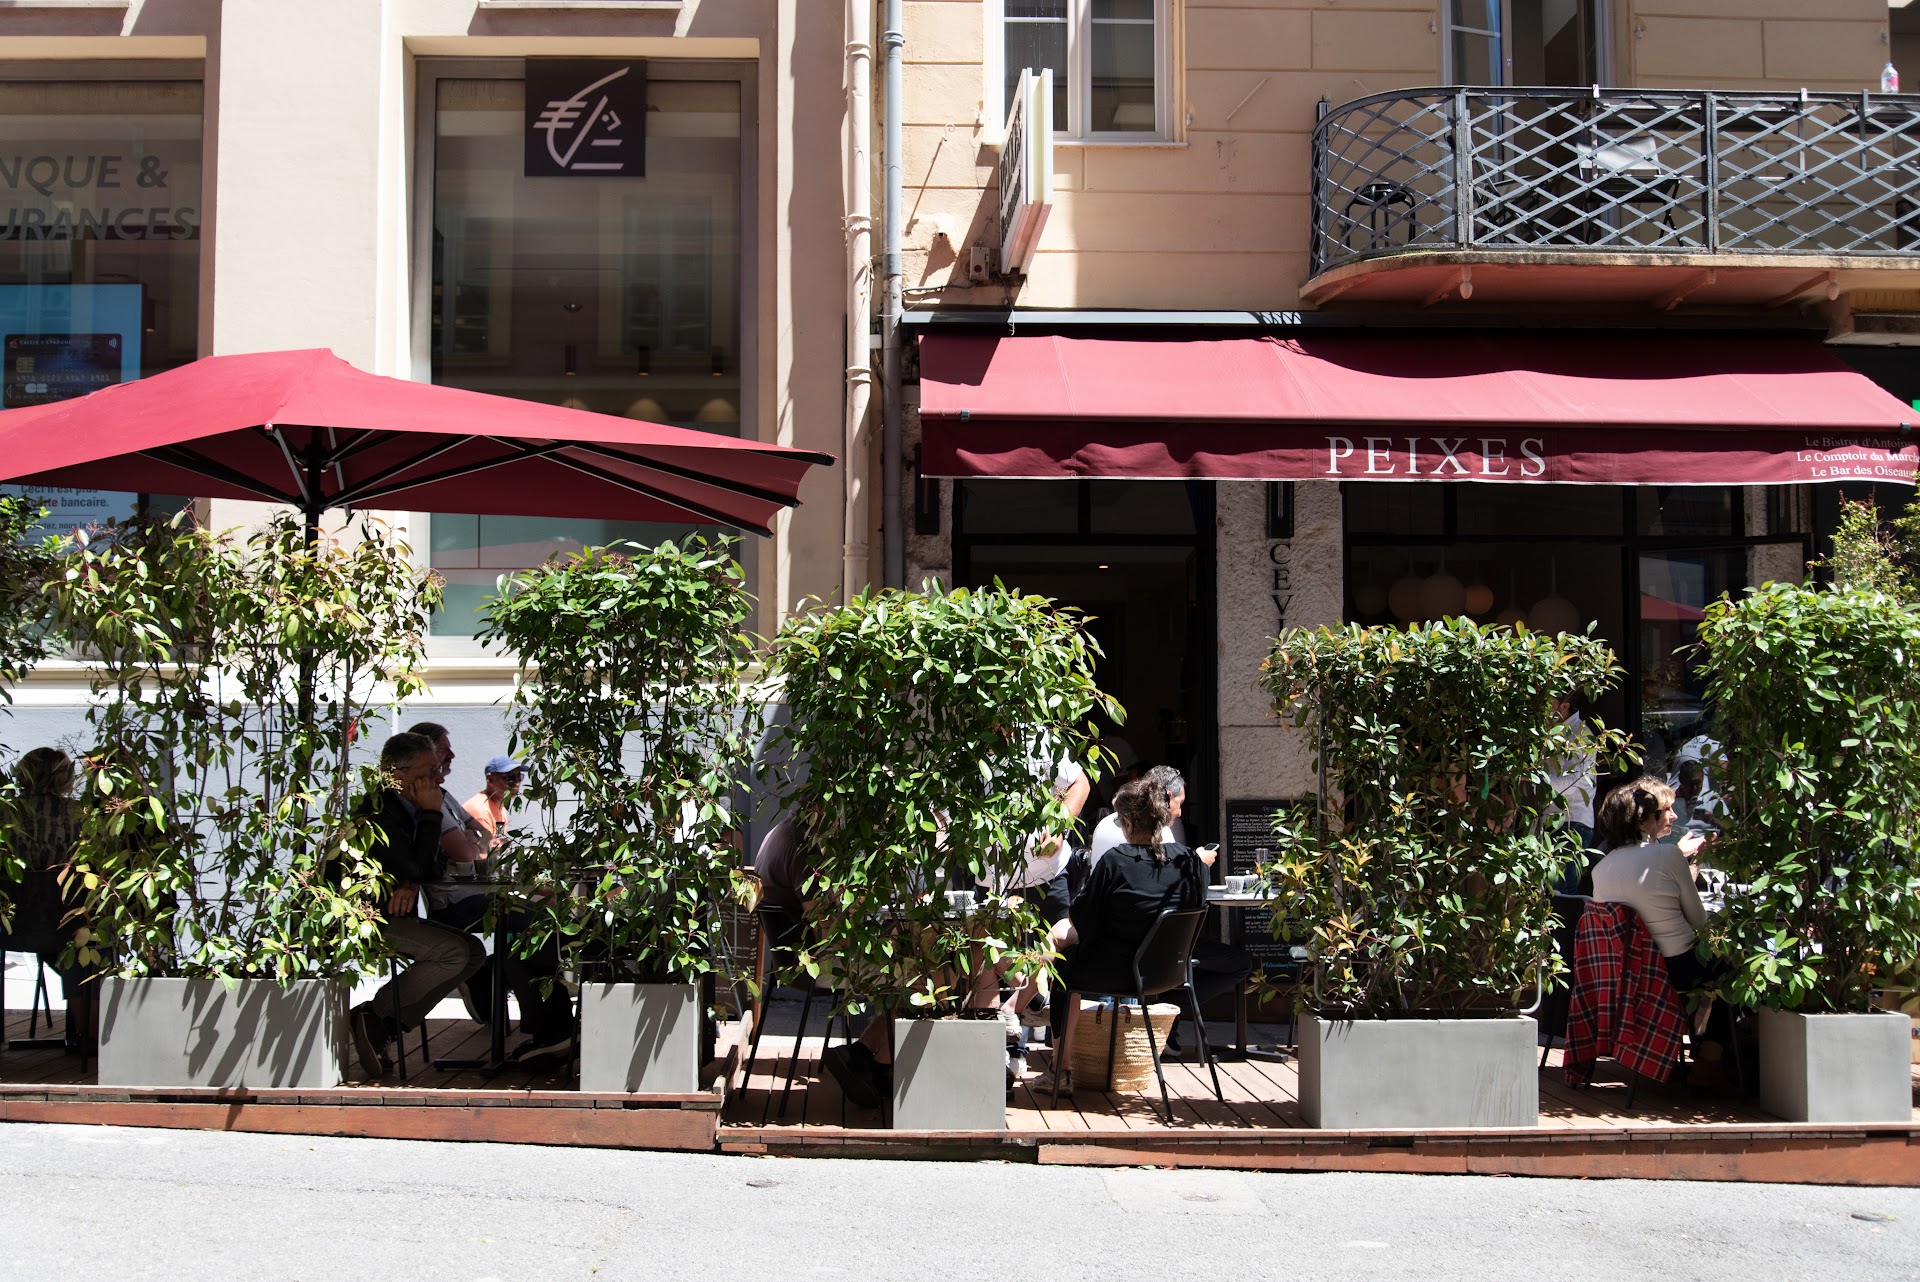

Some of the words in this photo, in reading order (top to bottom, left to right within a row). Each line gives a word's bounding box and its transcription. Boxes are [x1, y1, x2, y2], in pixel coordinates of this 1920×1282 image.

[136, 155, 169, 188] &
[1805, 436, 1820, 447] Le
[1325, 436, 1546, 477] PEIXES
[1796, 451, 1812, 462] Le
[1813, 450, 1868, 464] Comptoir
[1869, 451, 1885, 462] du
[1811, 467, 1827, 477] Le
[1829, 466, 1851, 476] Bar
[1853, 465, 1873, 475] des
[1874, 465, 1914, 479] Oiseau
[47, 486, 73, 494] nest
[60, 496, 109, 507] bancaire.
[1269, 543, 1294, 654] CEVI
